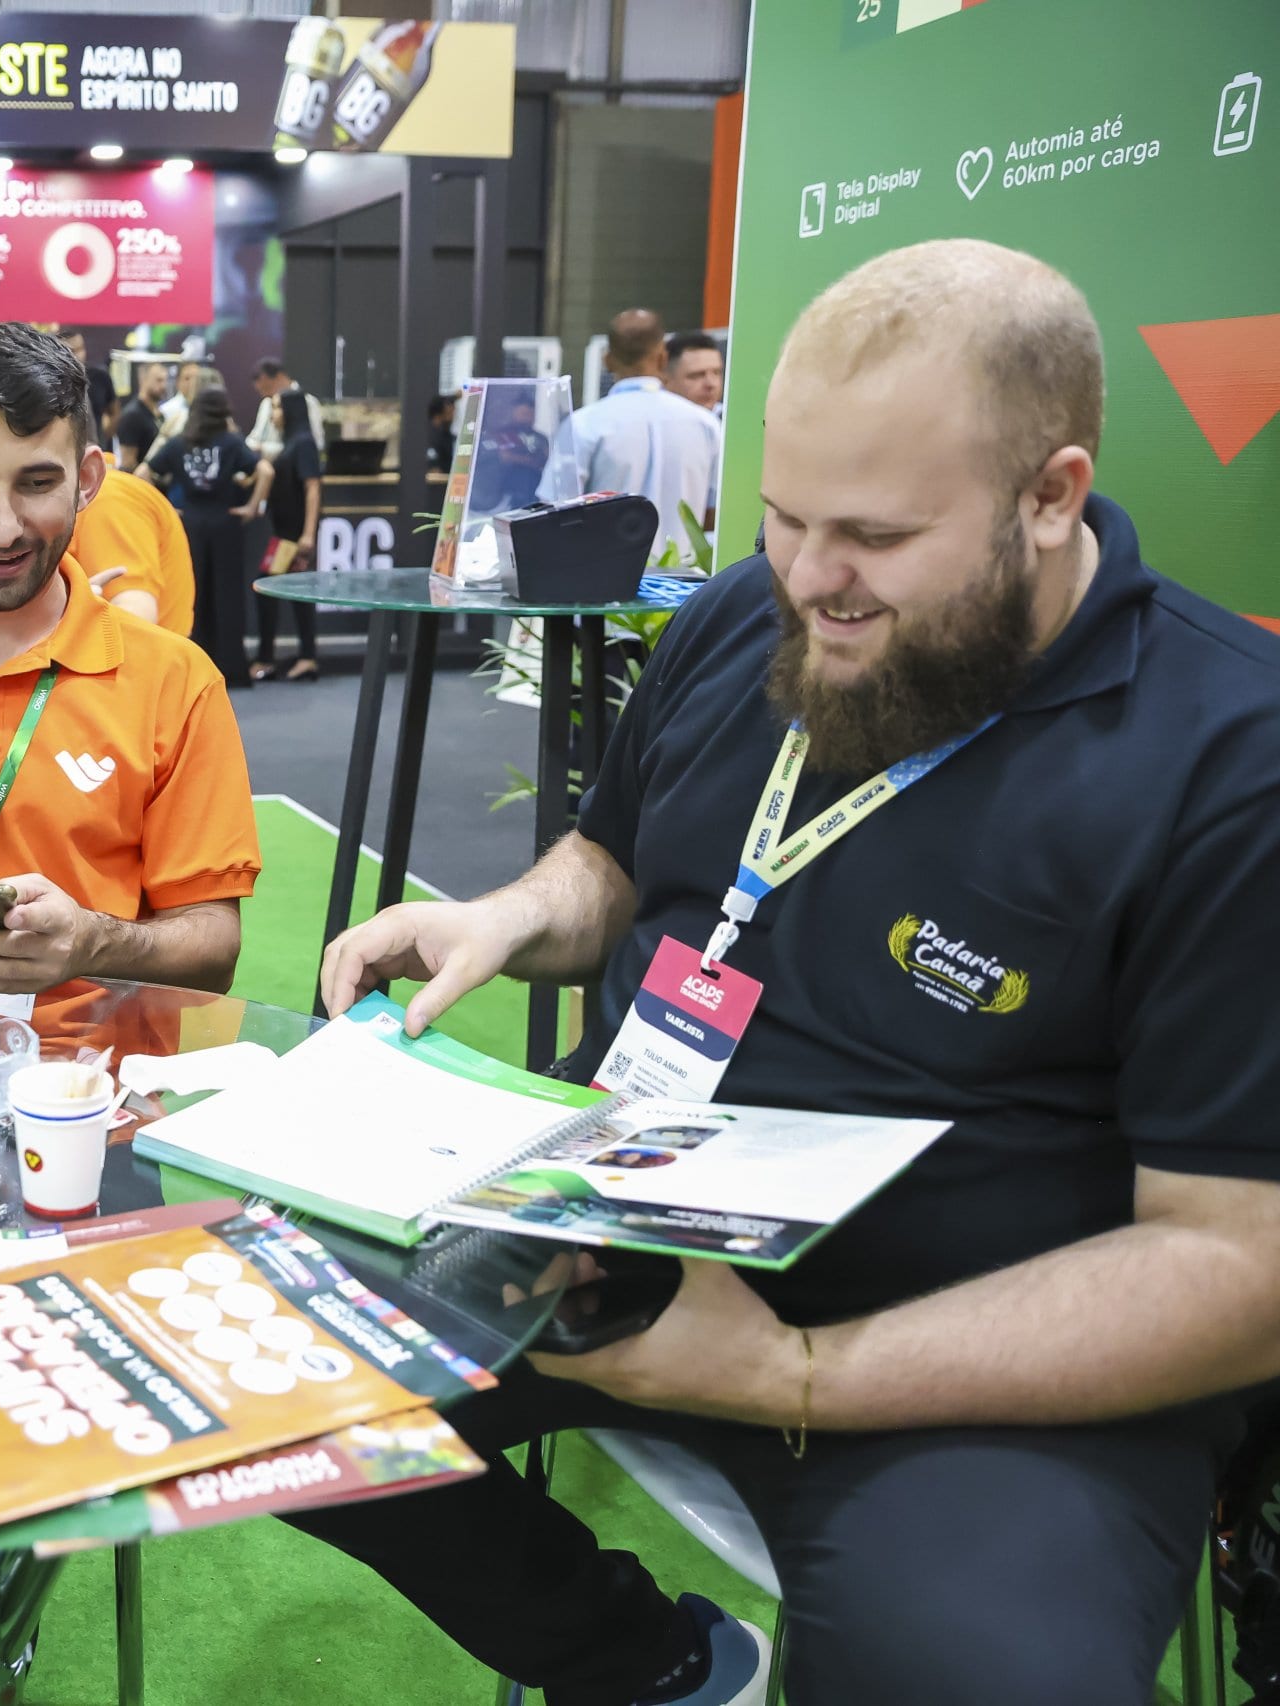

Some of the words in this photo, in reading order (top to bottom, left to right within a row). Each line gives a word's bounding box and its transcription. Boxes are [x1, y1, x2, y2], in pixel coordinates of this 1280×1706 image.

[856, 0, 881, 23] 25
[81, 46, 149, 77] AGORA
[152, 48, 182, 78] NO
[81, 73, 169, 111] ESPÍRITO
[172, 82, 239, 113] SANTO
[337, 72, 391, 137] BG
[1005, 126, 1084, 163] Automia
[1090, 113, 1123, 143] até
[1002, 162, 1055, 189] 60km
[1060, 153, 1095, 181] por
[1101, 139, 1160, 166] carga
[837, 179, 864, 200] Tela
[867, 167, 921, 193] Display
[834, 197, 880, 224] Digital
[116, 227, 182, 254] 250%
[769, 789, 785, 820] ACAPS
[816, 810, 844, 836] ACAPS
[917, 919, 1005, 980] Padaria
[915, 944, 985, 993] Canaã
[680, 985, 699, 1003] TRADE
[698, 996, 719, 1012] SHOW
[682, 974, 724, 1004] ACAPS
[665, 1011, 705, 1041] VAREJISTA
[662, 1060, 688, 1079] AMARO
